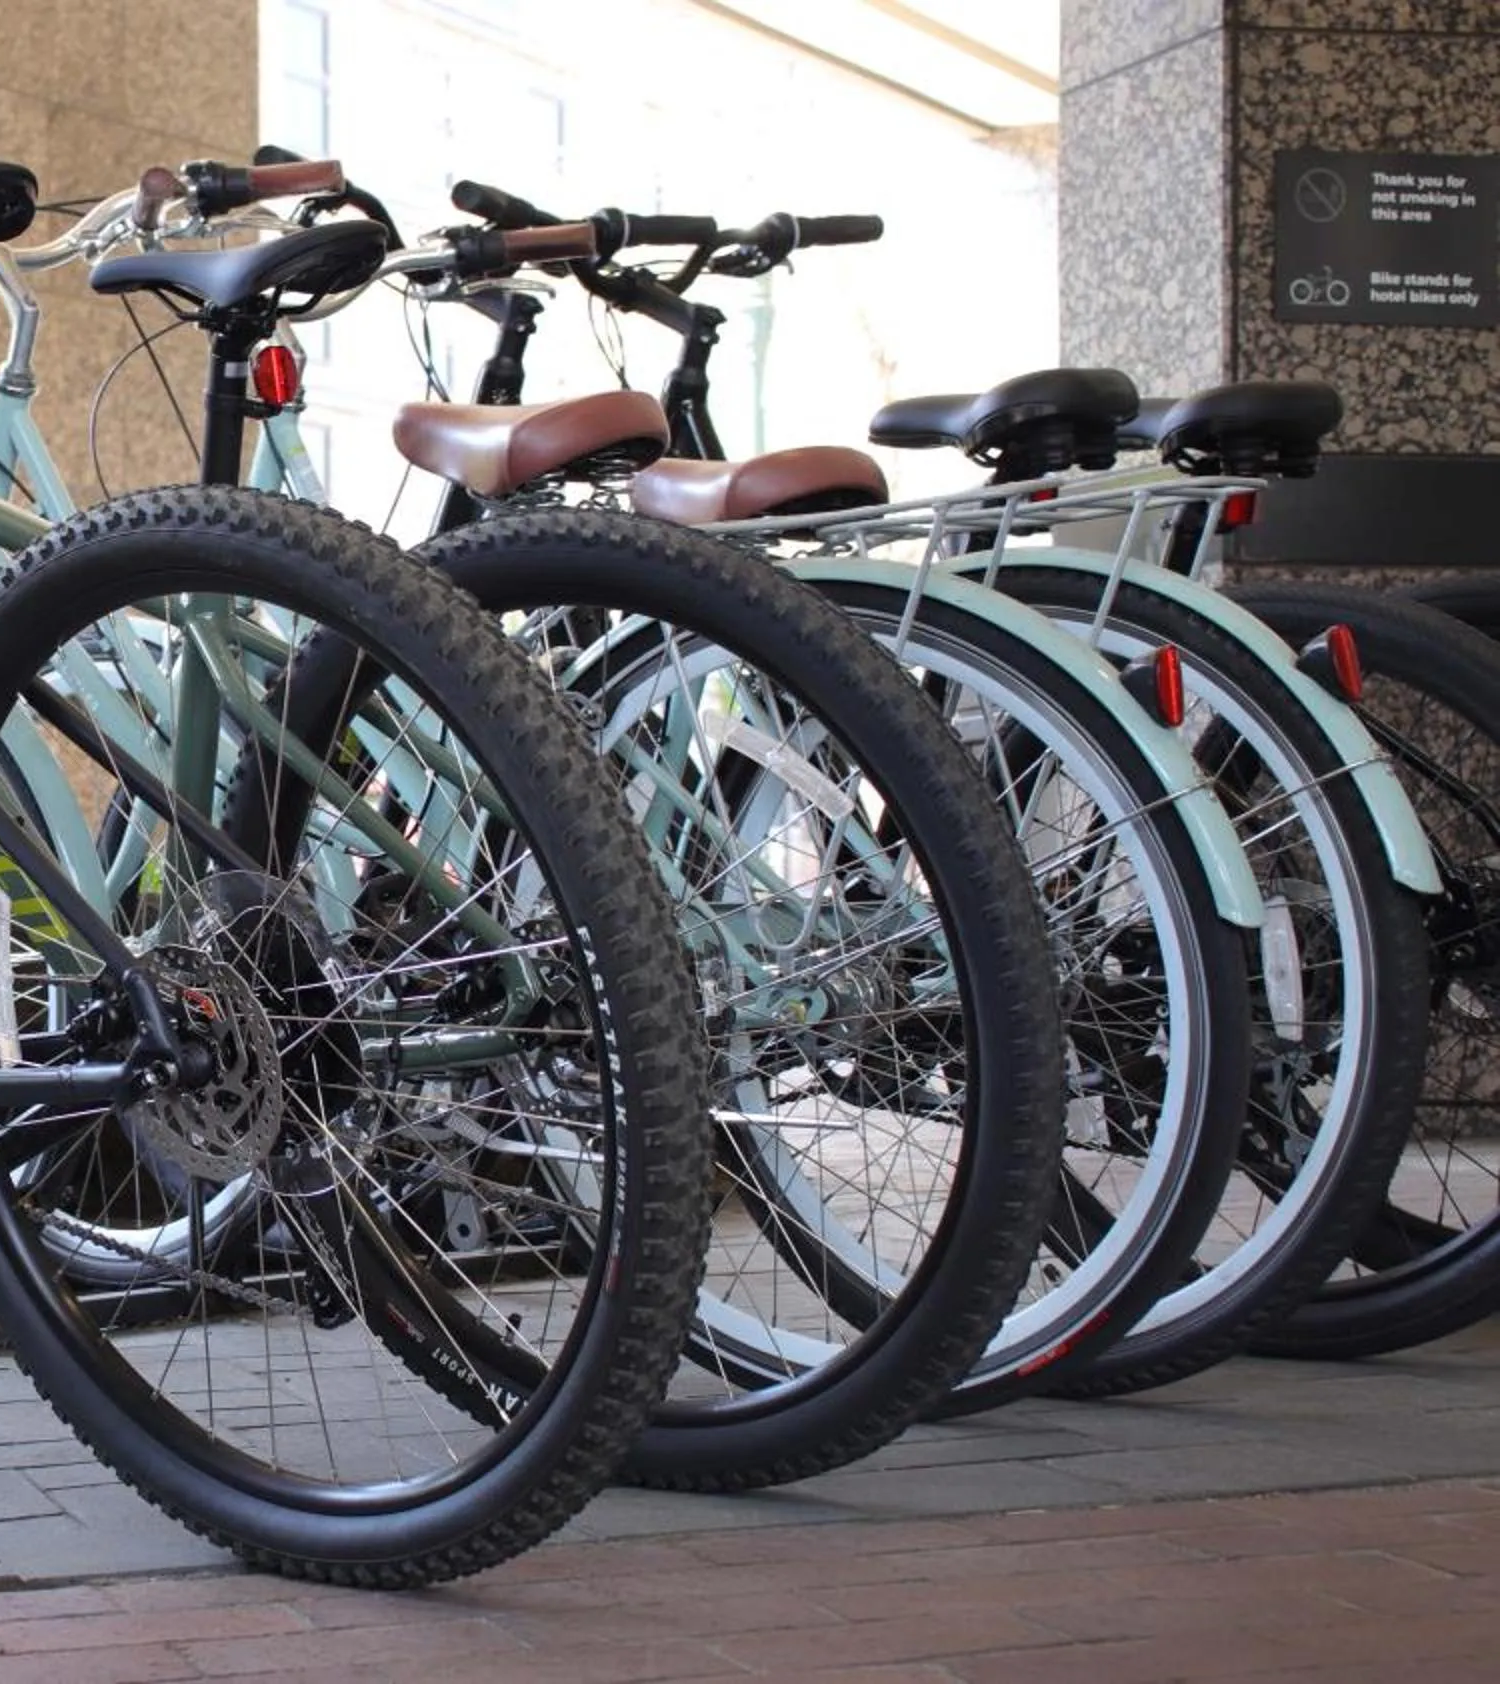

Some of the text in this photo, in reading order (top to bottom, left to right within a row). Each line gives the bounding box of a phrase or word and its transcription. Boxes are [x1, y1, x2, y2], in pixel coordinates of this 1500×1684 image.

[1372, 172, 1467, 190] Thank you for
[1371, 191, 1476, 208] not smoking in
[1371, 208, 1432, 222] this area
[1370, 271, 1473, 288] Bike stands for
[1369, 288, 1479, 308] hotel bikes only
[576, 926, 628, 1216] FAST TRAK SPORT
[431, 1347, 480, 1386] SPORT
